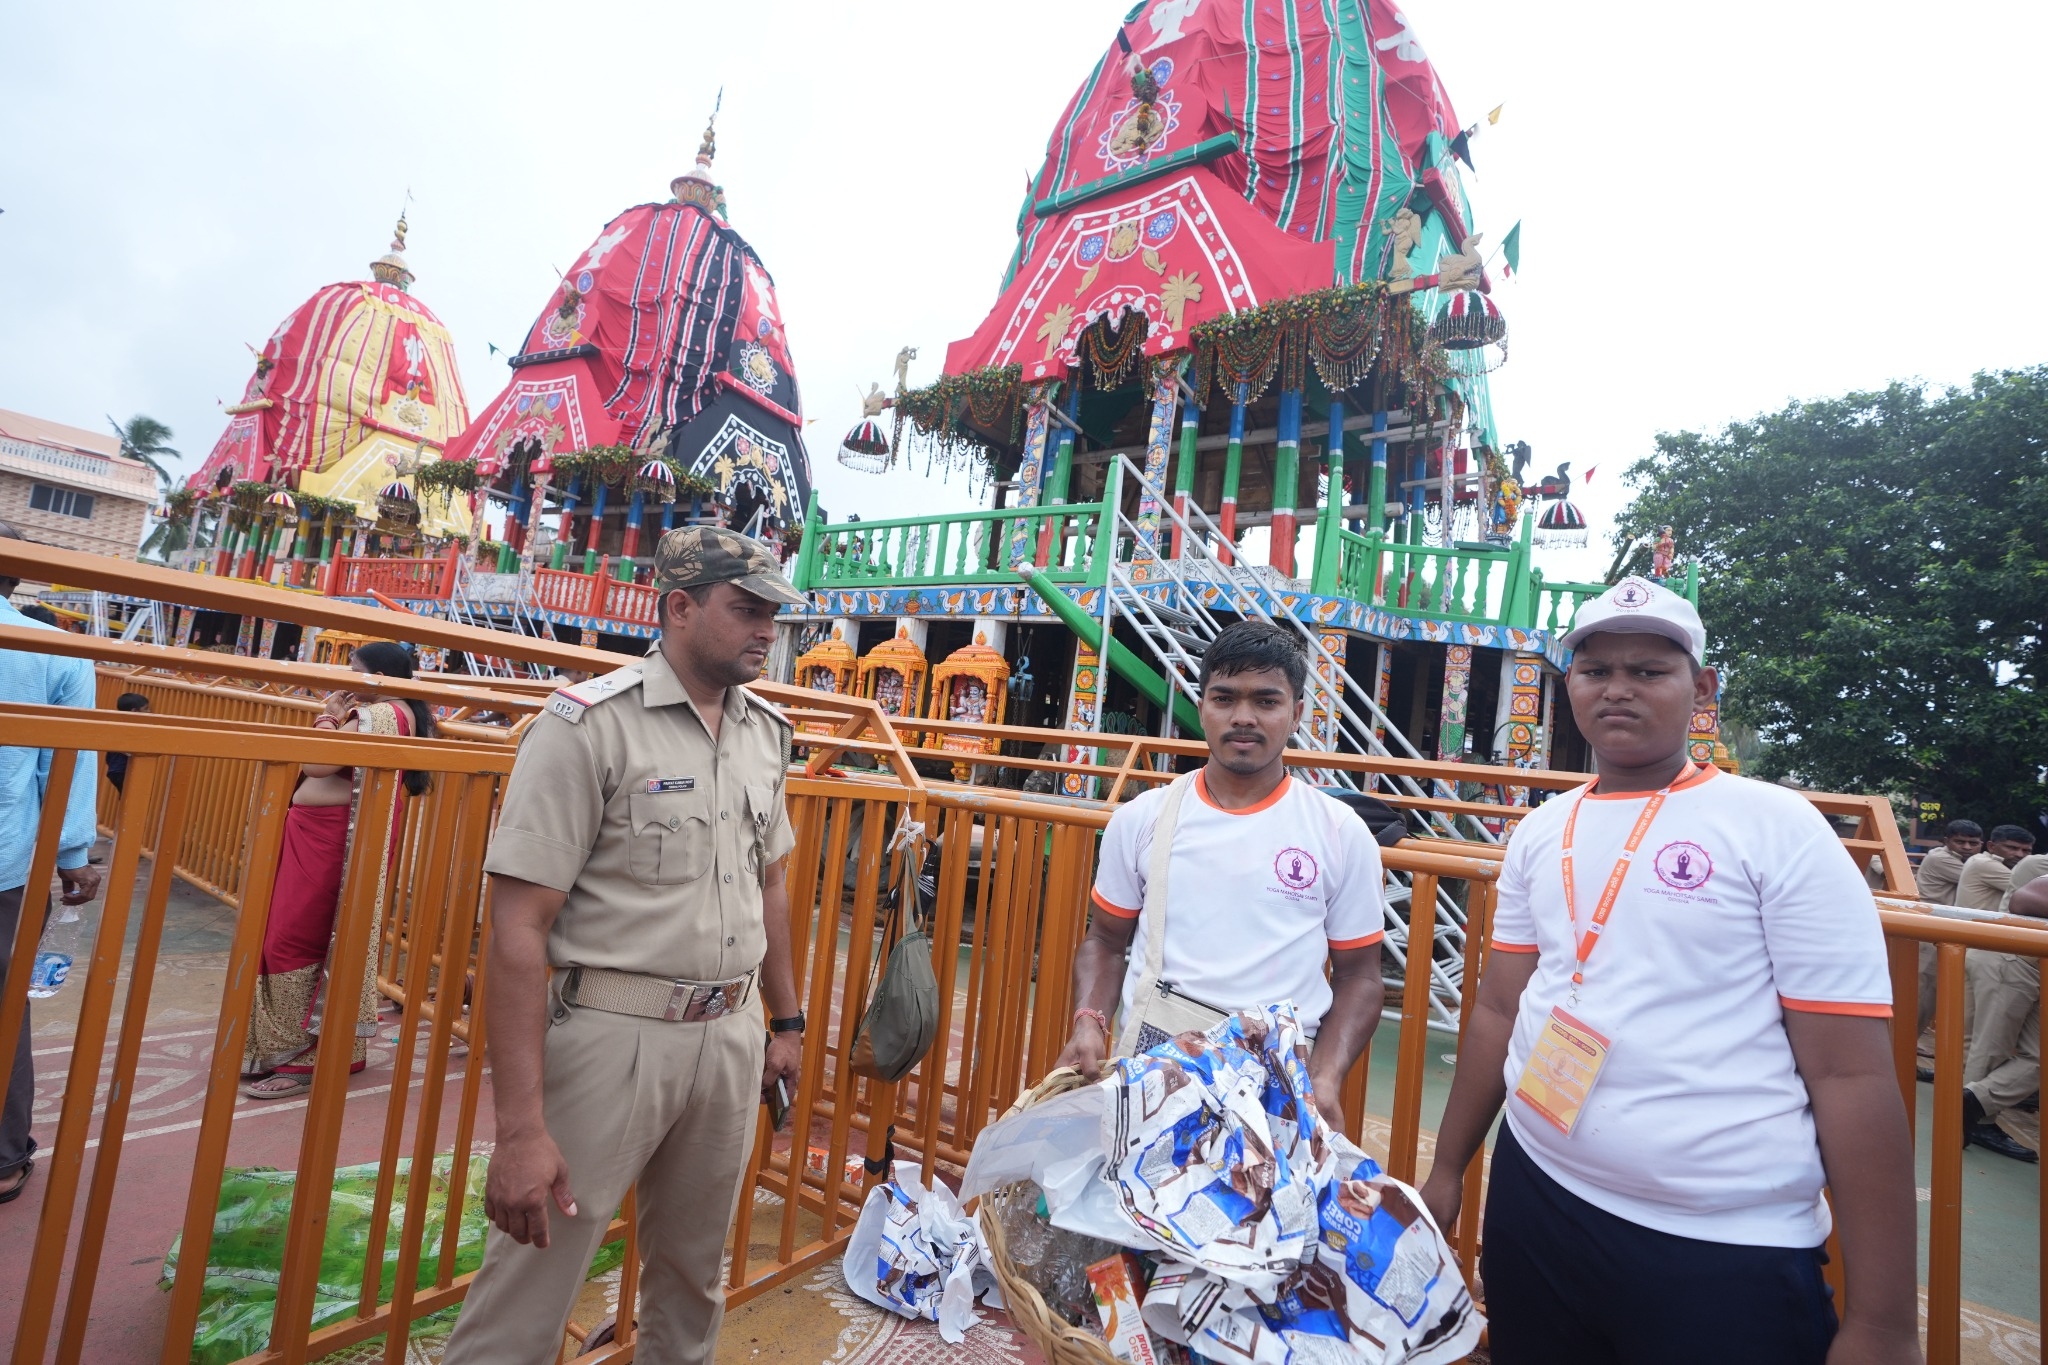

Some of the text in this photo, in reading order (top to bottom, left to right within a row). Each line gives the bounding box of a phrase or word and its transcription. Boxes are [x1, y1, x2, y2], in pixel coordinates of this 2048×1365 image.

[1643, 887, 1718, 905] YOGA MAHOTSAV SAMITI
[1667, 896, 1690, 905] ODISHA
[1128, 1336, 1142, 1363] ORS
